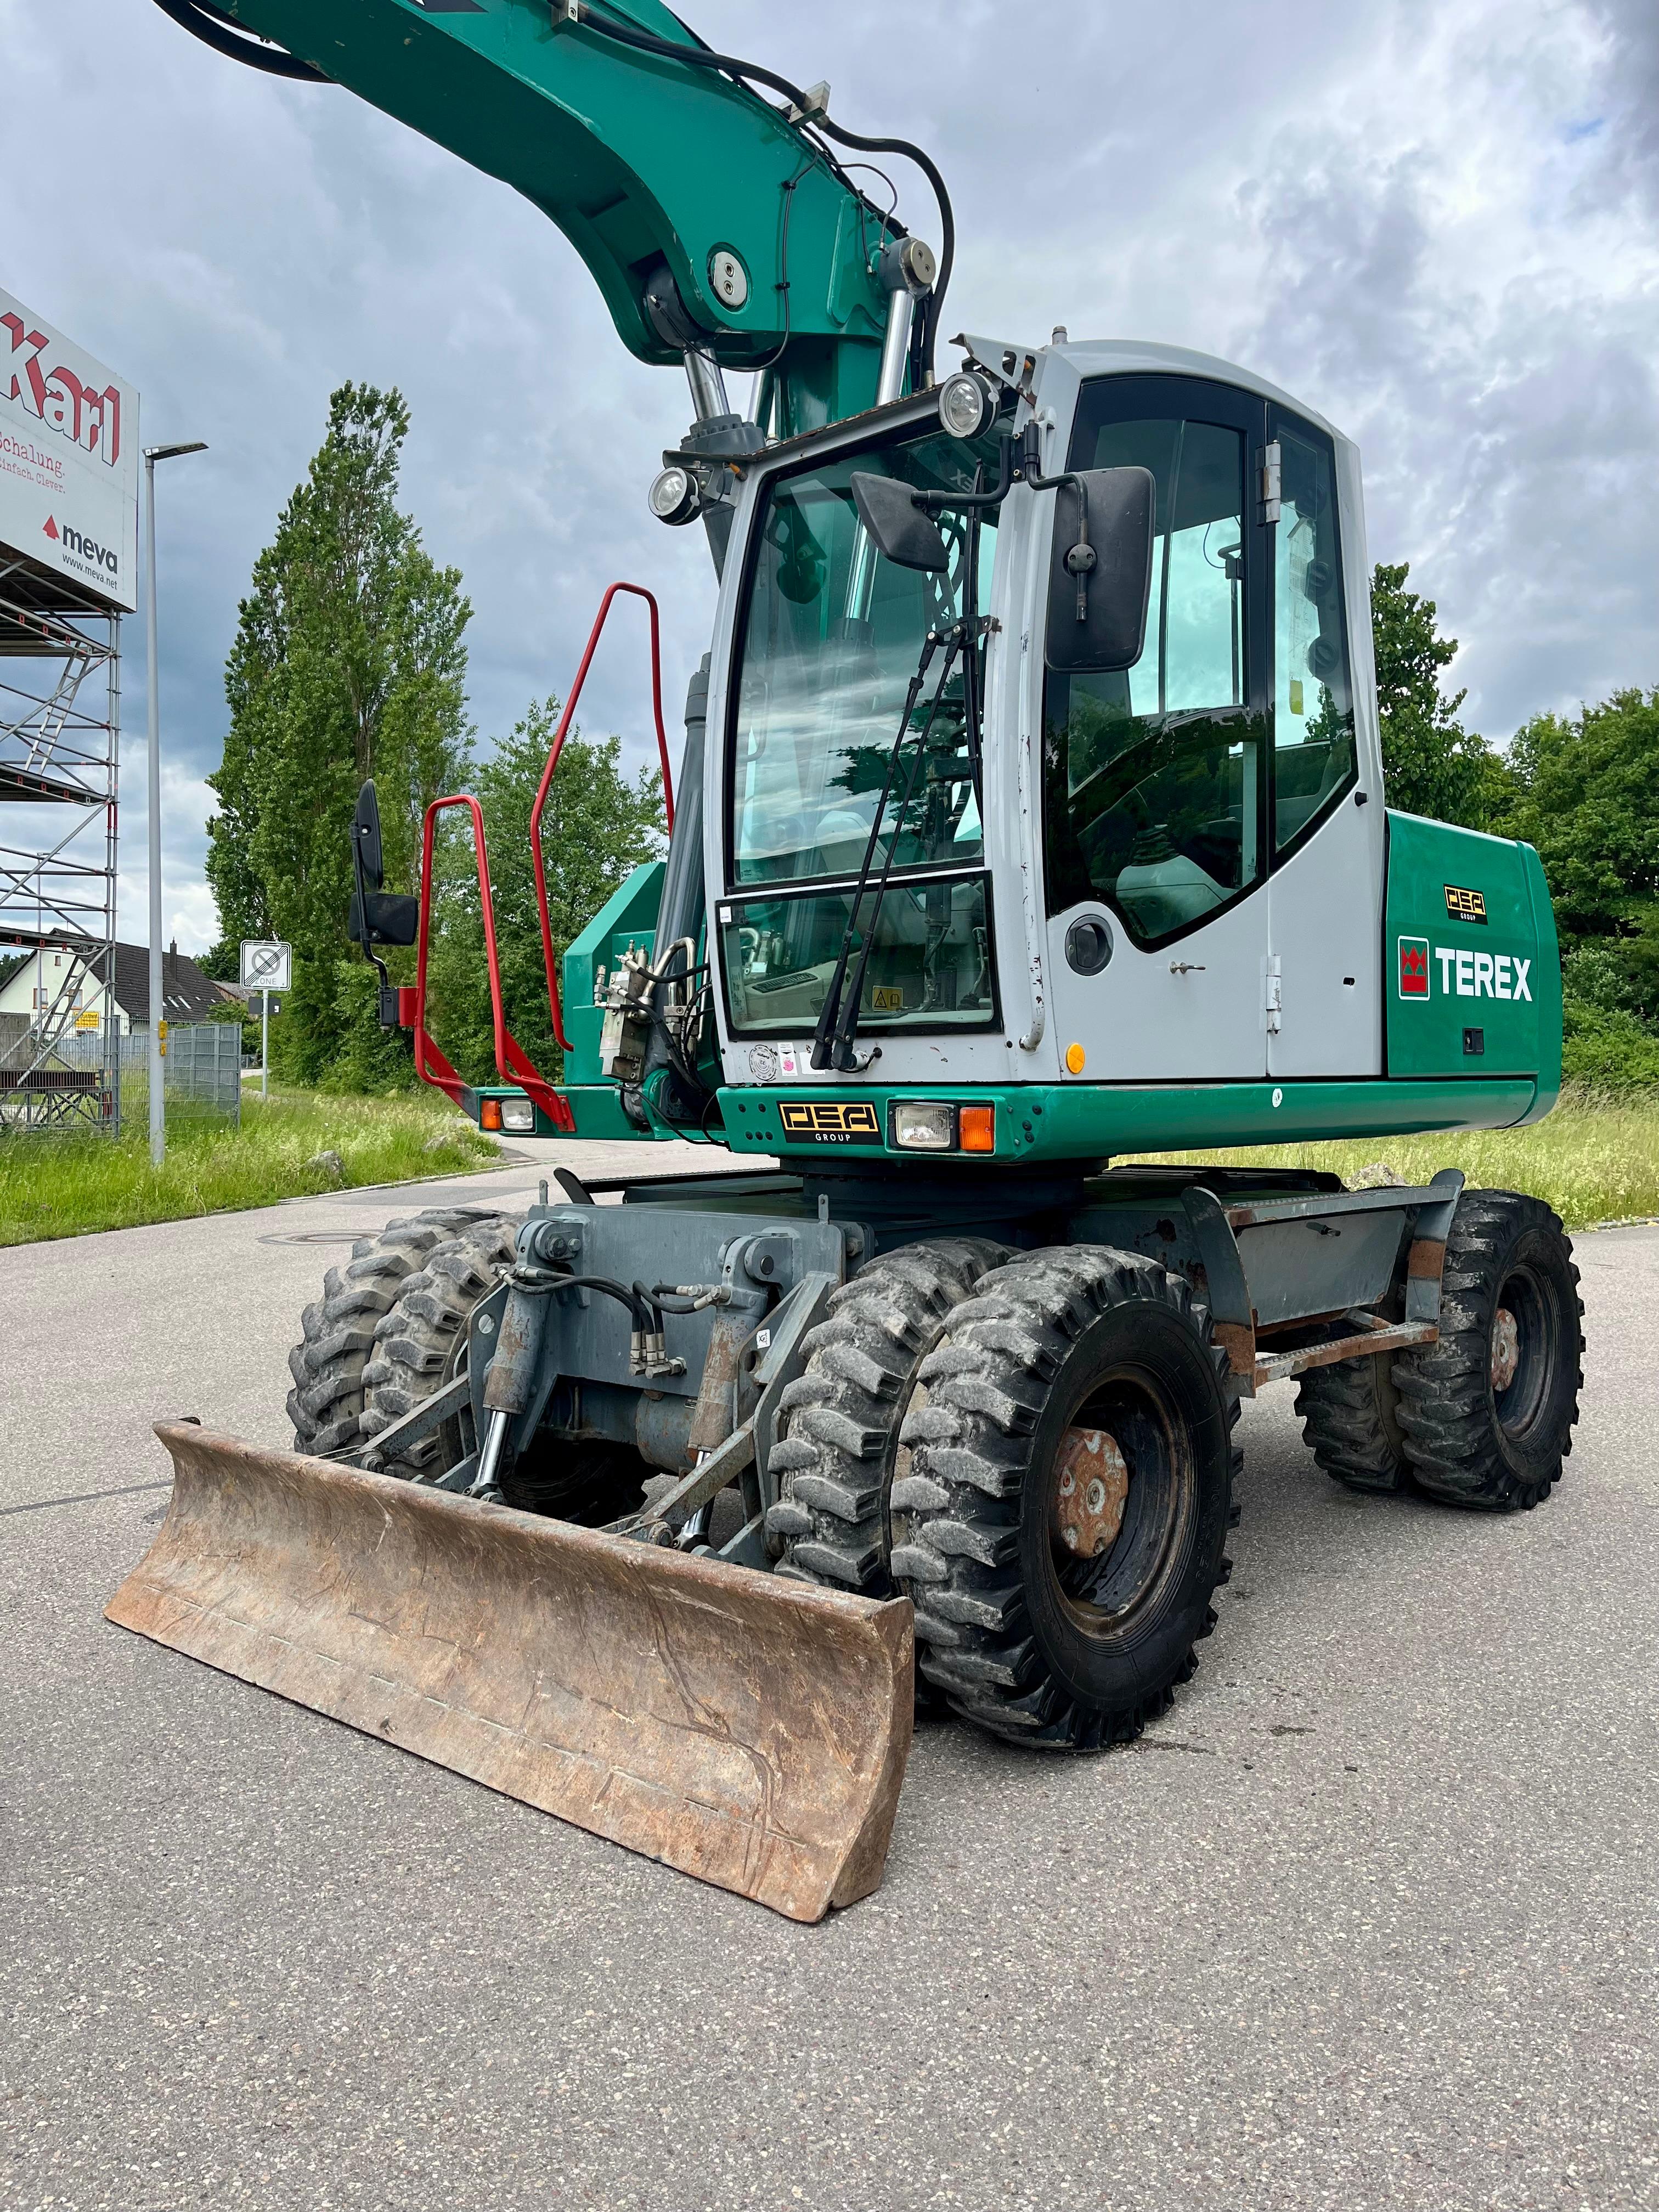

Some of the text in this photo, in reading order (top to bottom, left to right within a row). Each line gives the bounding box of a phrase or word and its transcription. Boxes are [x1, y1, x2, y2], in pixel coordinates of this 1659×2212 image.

[0, 458, 65, 494] infach. Clever.
[63, 525, 117, 574] meva
[63, 553, 117, 590] www.meva.net
[1460, 912, 1476, 921] GROUP
[1435, 947, 1532, 1001] TEREX
[815, 1133, 850, 1142] GROUP
